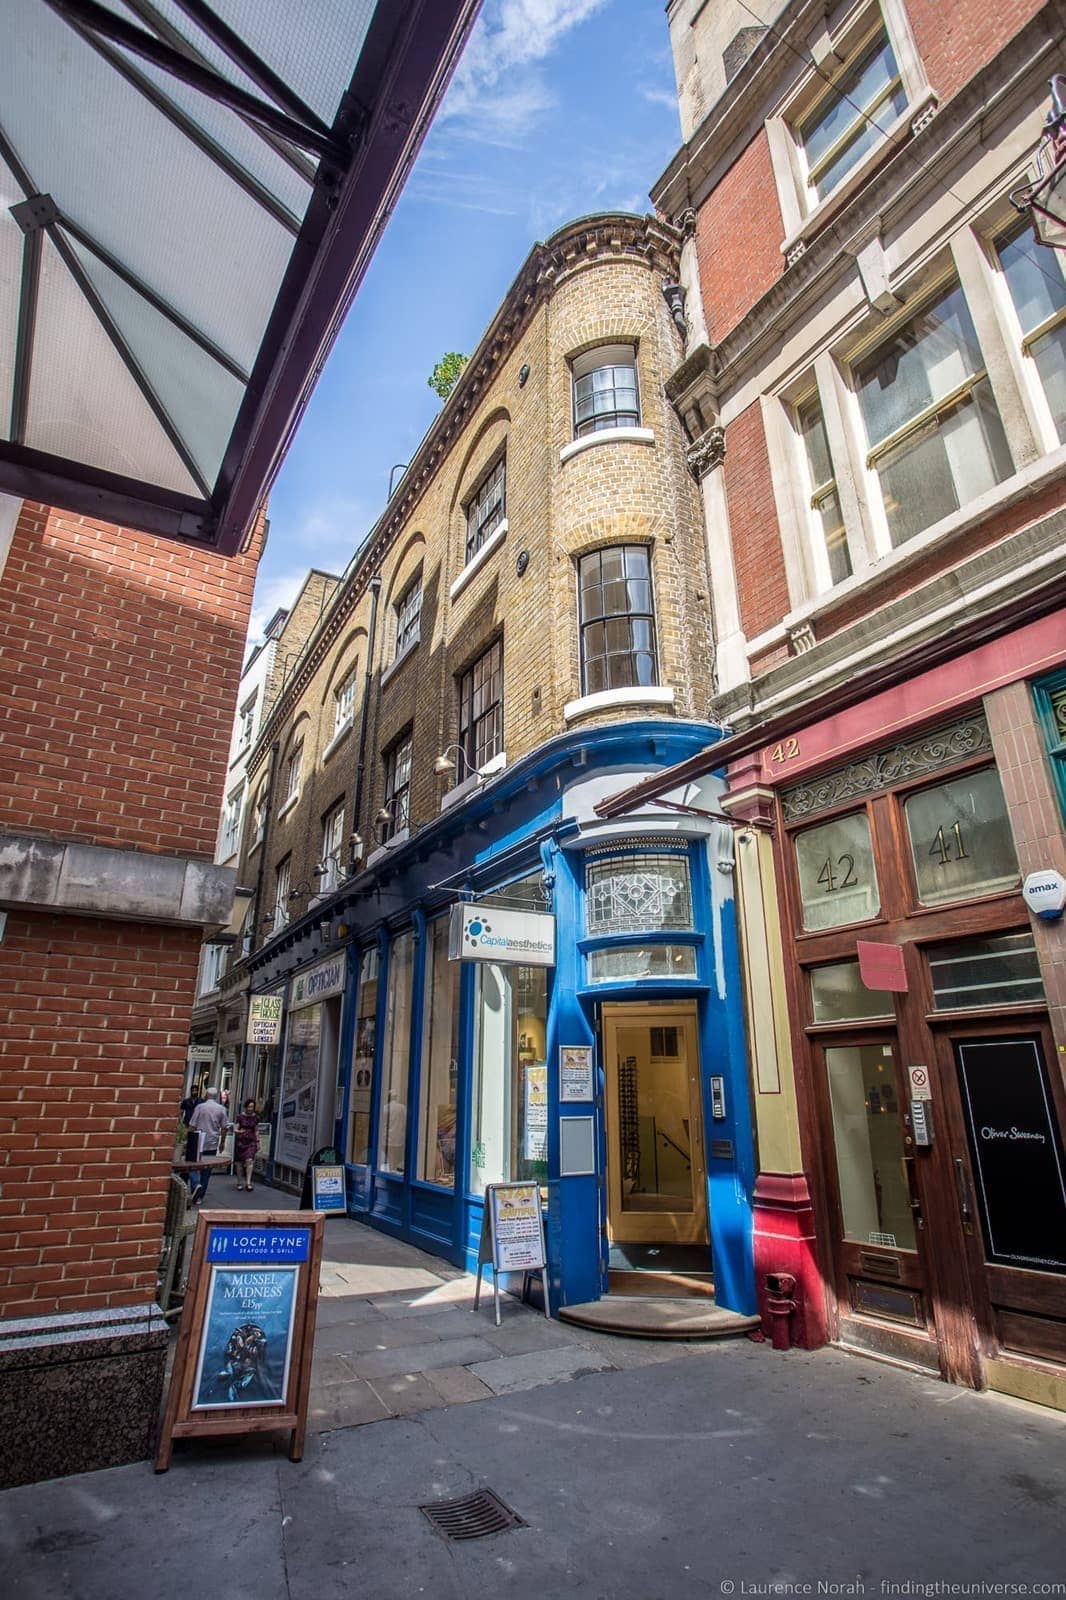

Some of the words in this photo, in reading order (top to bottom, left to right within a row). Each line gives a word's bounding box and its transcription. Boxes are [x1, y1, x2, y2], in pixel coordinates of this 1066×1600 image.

[771, 738, 800, 763] 42
[928, 821, 970, 865] 41
[817, 853, 859, 893] 42
[1028, 882, 1058, 894] amax
[308, 963, 340, 996] OPTICIAN
[253, 1021, 277, 1029] OPTICIAN
[253, 1028, 276, 1036] CONTACT
[254, 1035, 273, 1043] LENSES
[232, 1237, 266, 1247] LOCH
[271, 1237, 303, 1247] FYNE
[232, 1273, 278, 1286] MUSSEL
[223, 1286, 283, 1299] MADNESS
